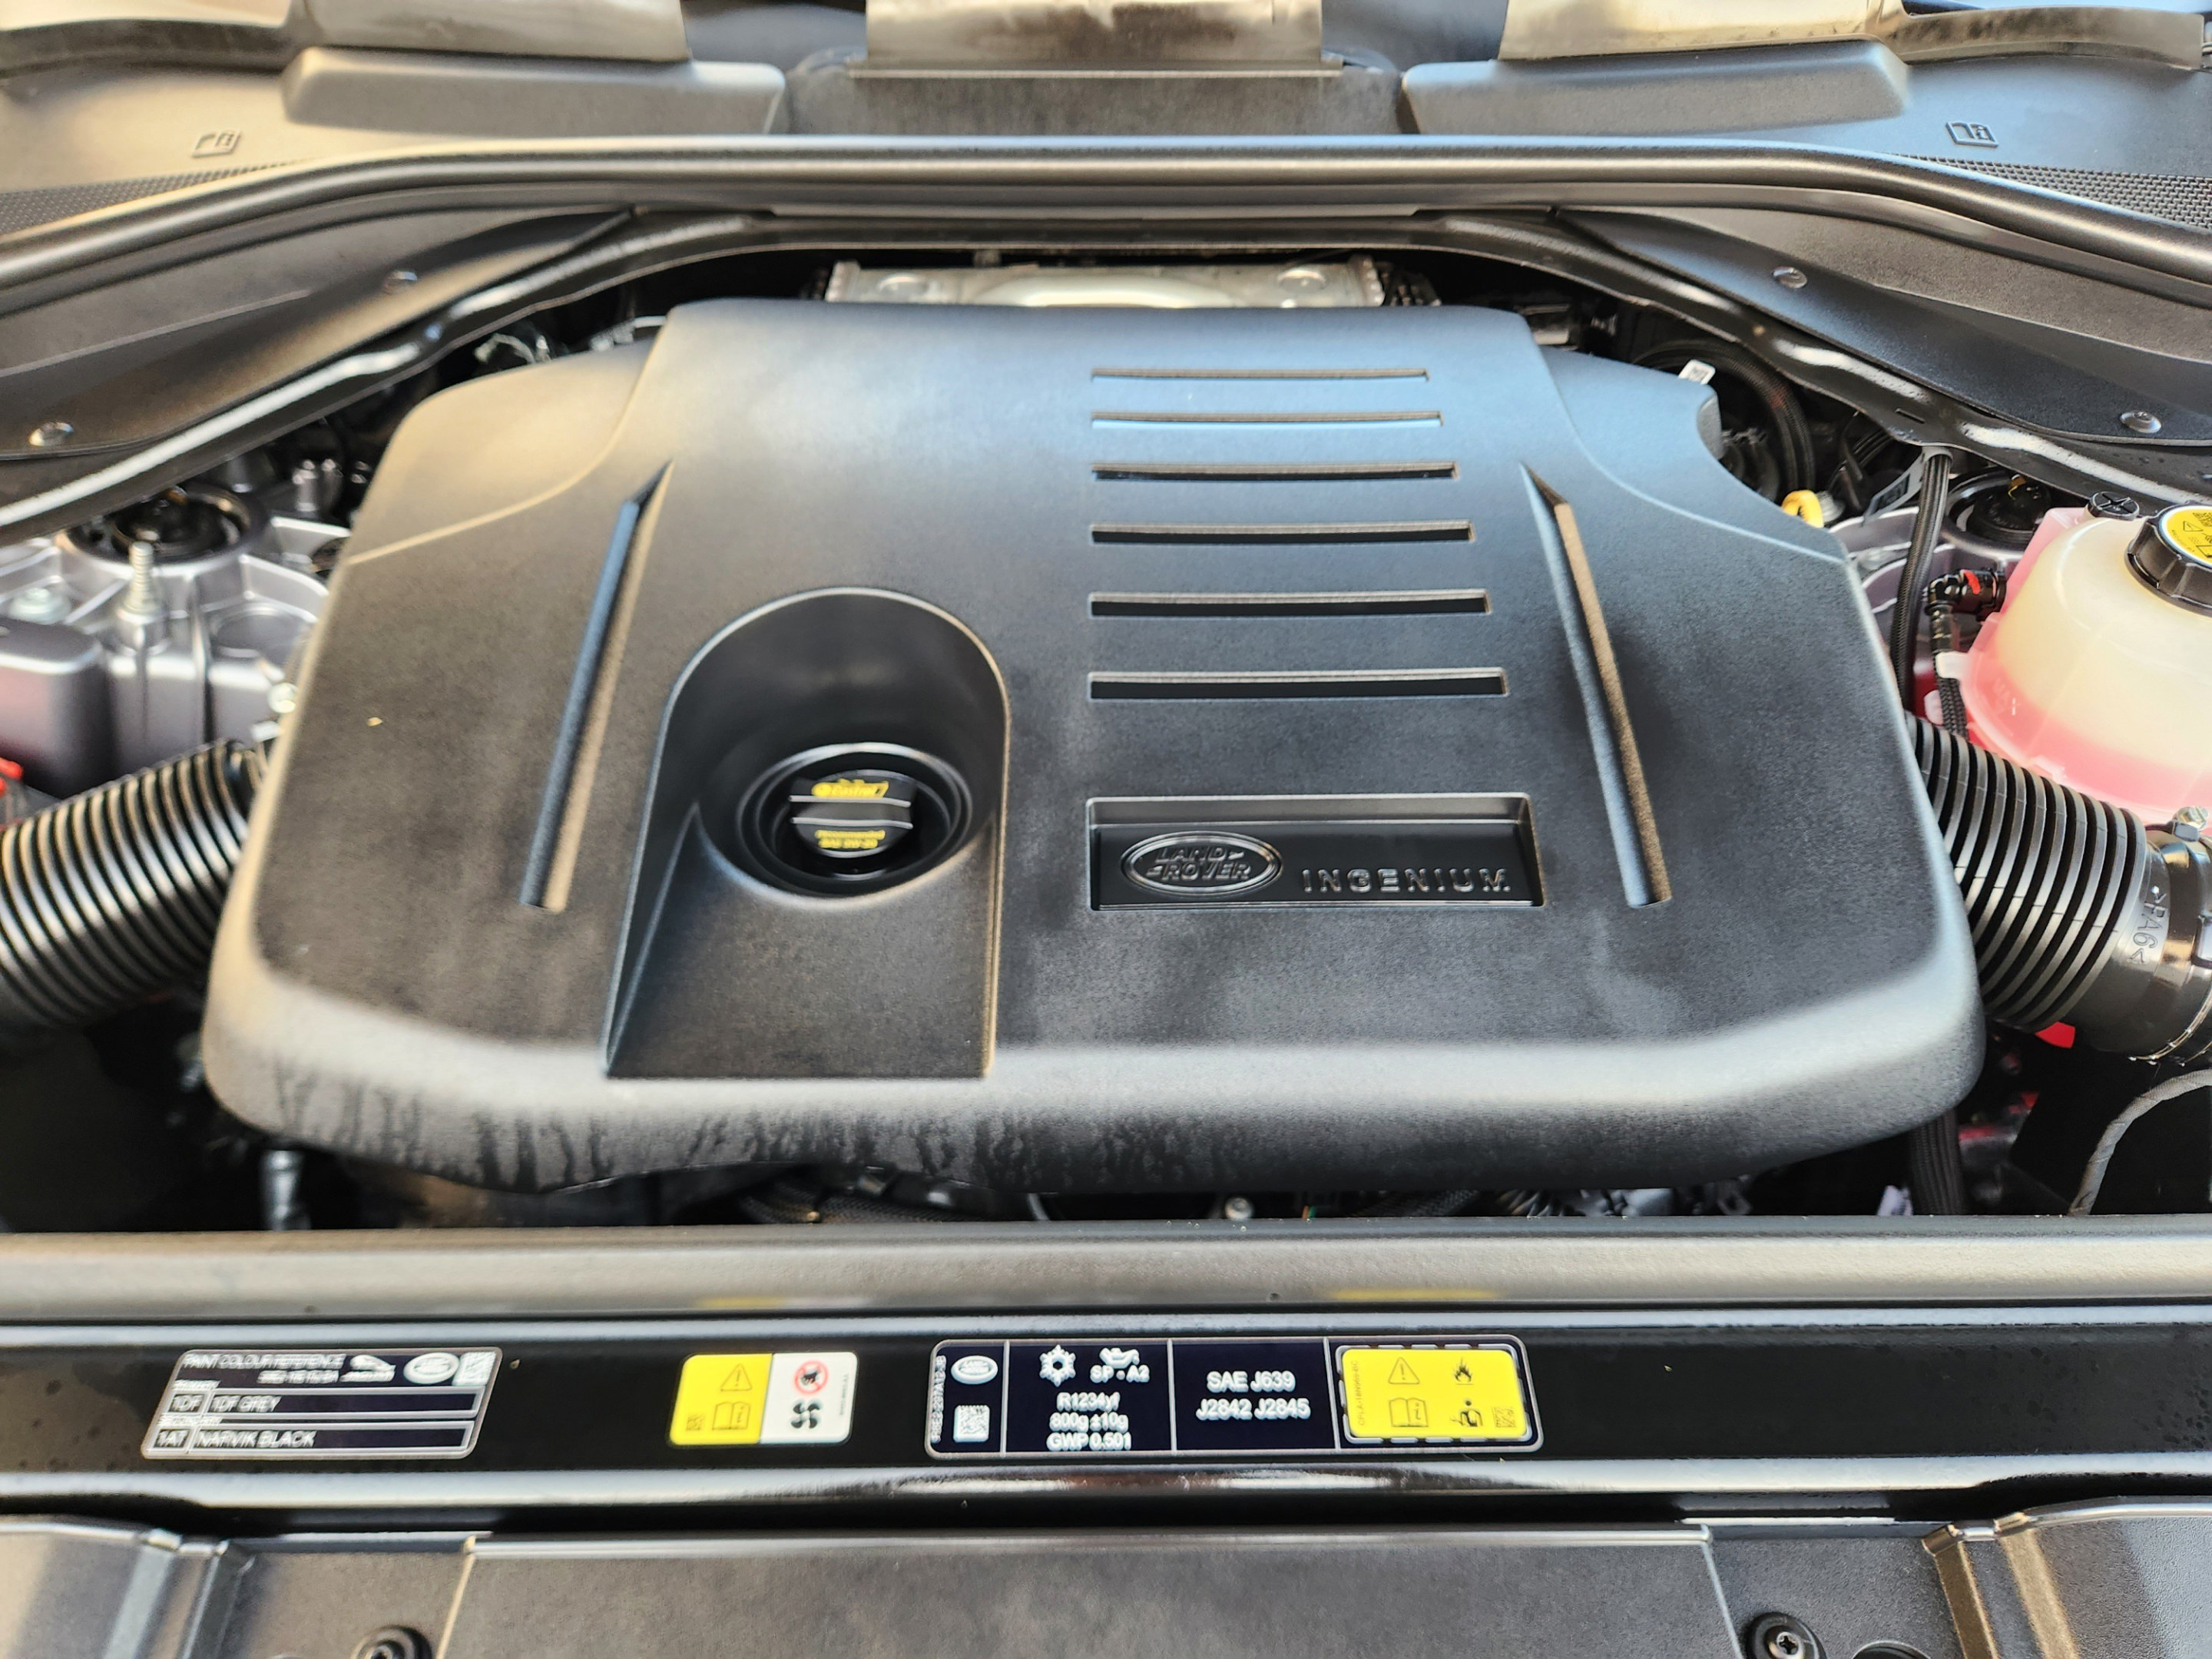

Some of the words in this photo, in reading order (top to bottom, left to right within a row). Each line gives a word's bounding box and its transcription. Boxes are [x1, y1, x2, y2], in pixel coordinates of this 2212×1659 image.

[1155, 847, 1229, 863] LAND
[1161, 862, 1252, 881] ROVER
[1302, 868, 1512, 893] INGENIUM
[183, 1354, 220, 1369] PAINT
[1207, 1370, 1249, 1392] SAE
[1250, 1370, 1296, 1392] J639
[236, 1395, 281, 1412] GREY
[1057, 1392, 1121, 1412] R1234yf
[1196, 1398, 1253, 1420] J2842
[1254, 1398, 1311, 1420] J2845
[194, 1429, 259, 1448] NARVIK
[256, 1429, 317, 1448] BLACK
[1046, 1432, 1089, 1451] GWP
[1089, 1432, 1131, 1451] 0.501
